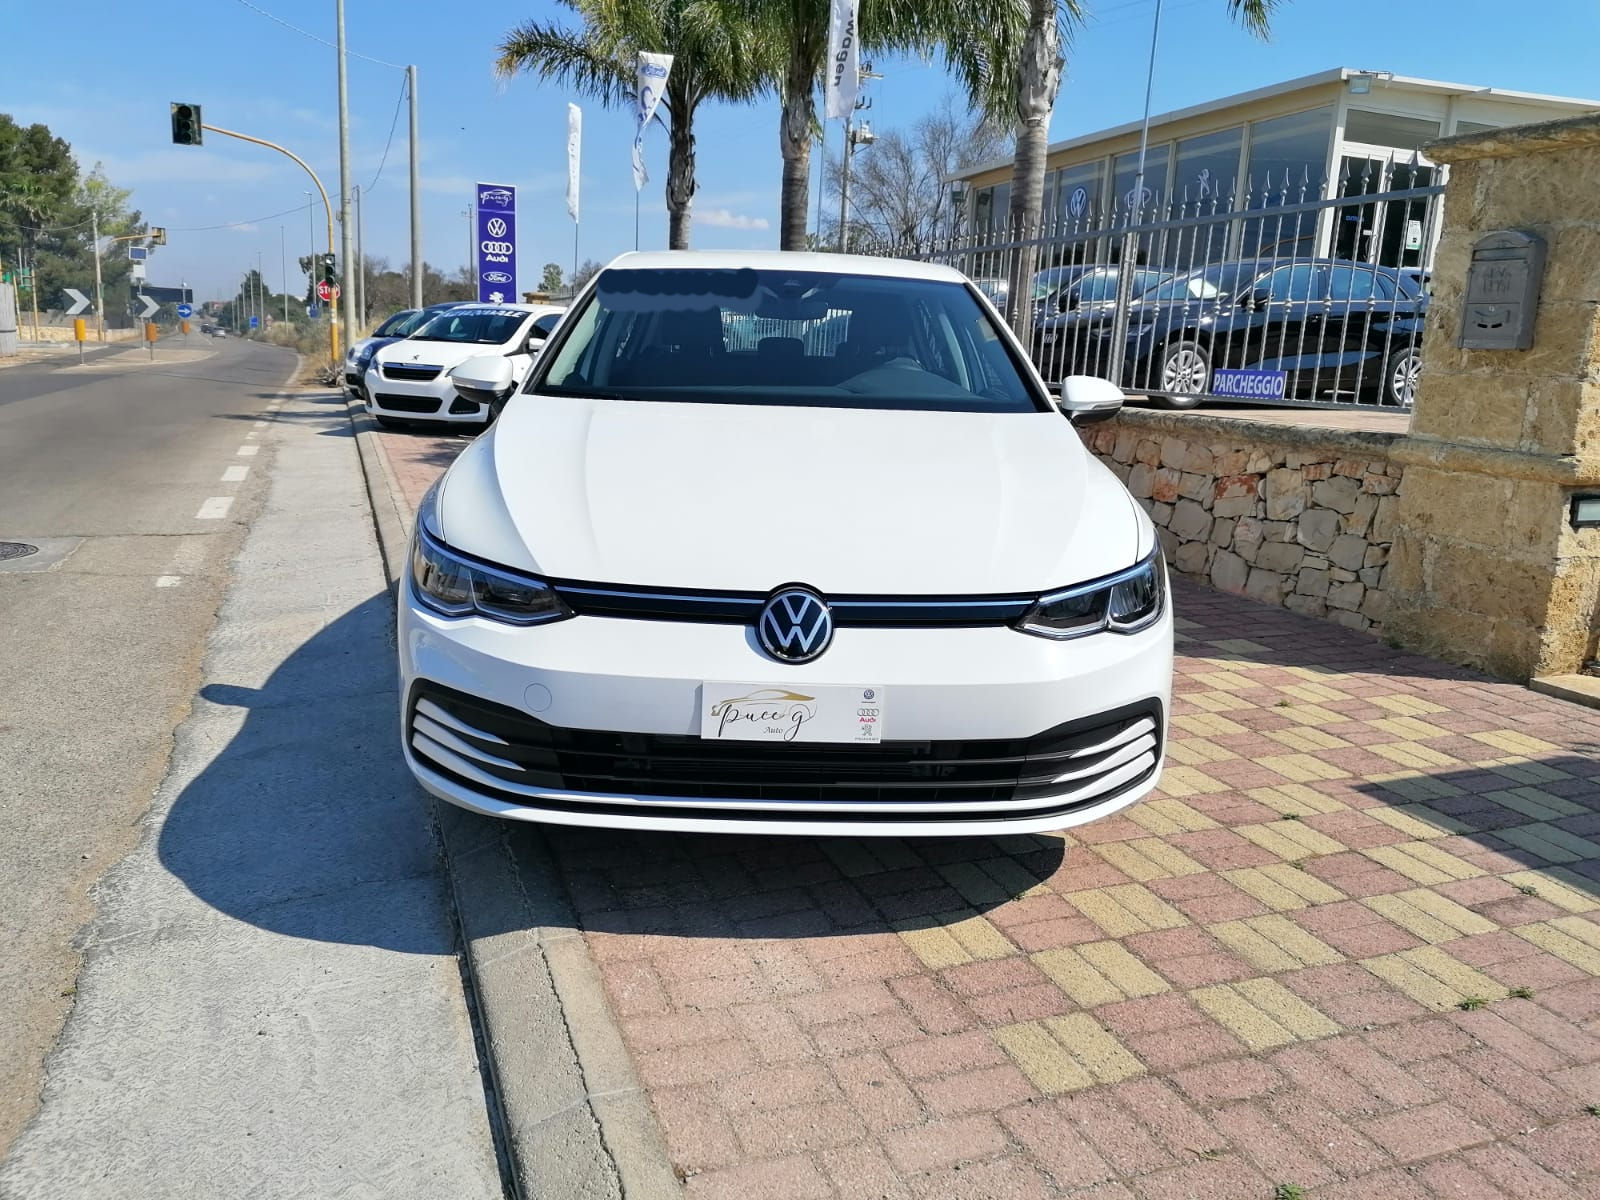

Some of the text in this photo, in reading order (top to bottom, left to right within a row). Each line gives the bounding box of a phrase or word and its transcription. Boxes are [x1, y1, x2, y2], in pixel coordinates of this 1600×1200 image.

[485, 254, 508, 262] Audi
[1213, 373, 1284, 395] PARCHEGGIO
[763, 726, 783, 734] Auto
